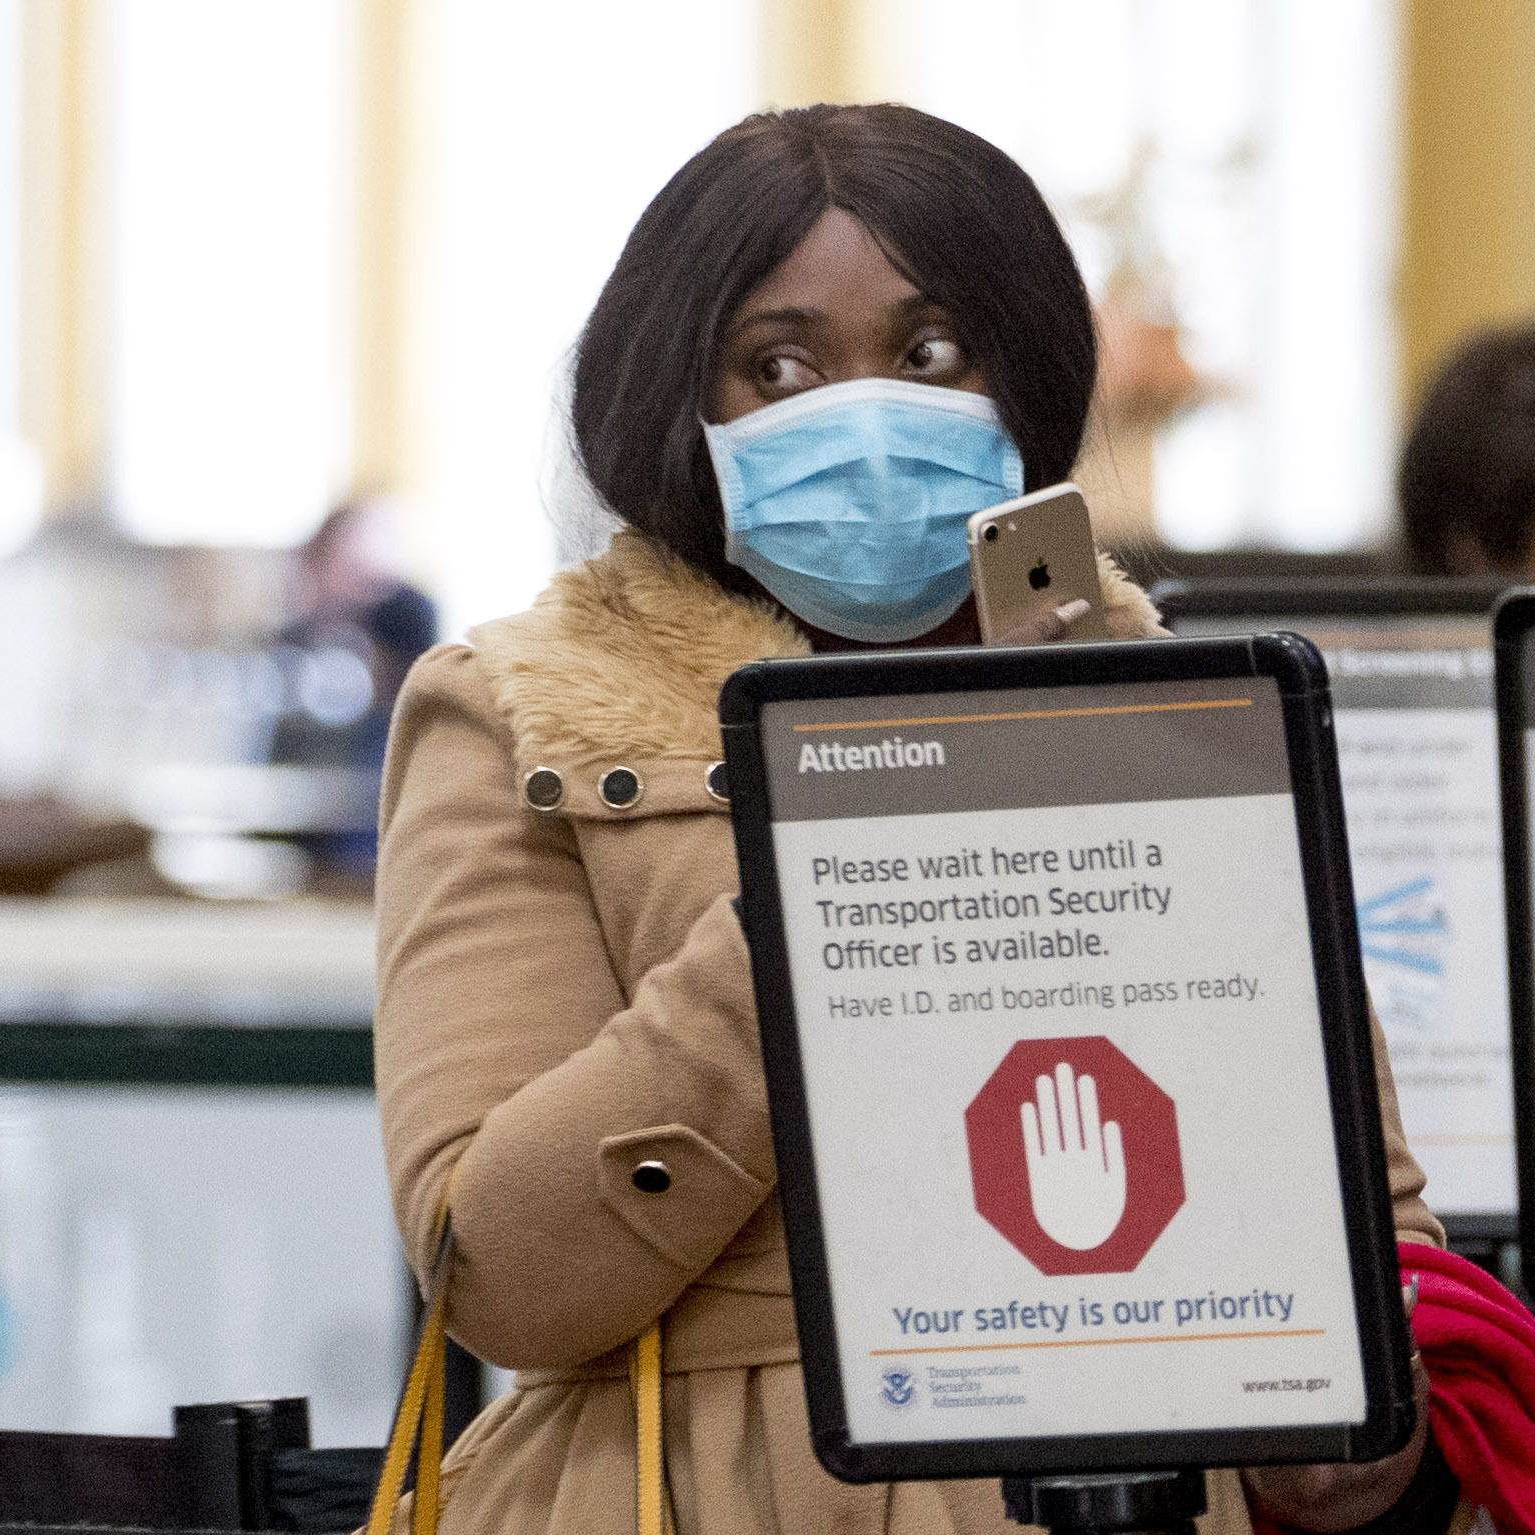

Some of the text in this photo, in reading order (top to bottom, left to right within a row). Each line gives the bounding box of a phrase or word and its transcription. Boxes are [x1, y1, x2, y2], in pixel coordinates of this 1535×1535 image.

[798, 737, 945, 773] Attention
[812, 839, 1163, 885] Please wait here until a
[816, 882, 1172, 928] Transportation Security
[823, 928, 1110, 970] Officer is available.
[828, 973, 1266, 1019] Have I.D. and boarding pass ready.
[893, 1289, 1294, 1334] Your safety is our priority
[927, 1366, 1021, 1381] Transportation
[929, 1381, 981, 1394] Security
[1242, 1378, 1331, 1393] www.tsa.gov
[932, 1395, 1026, 1408] Administration
